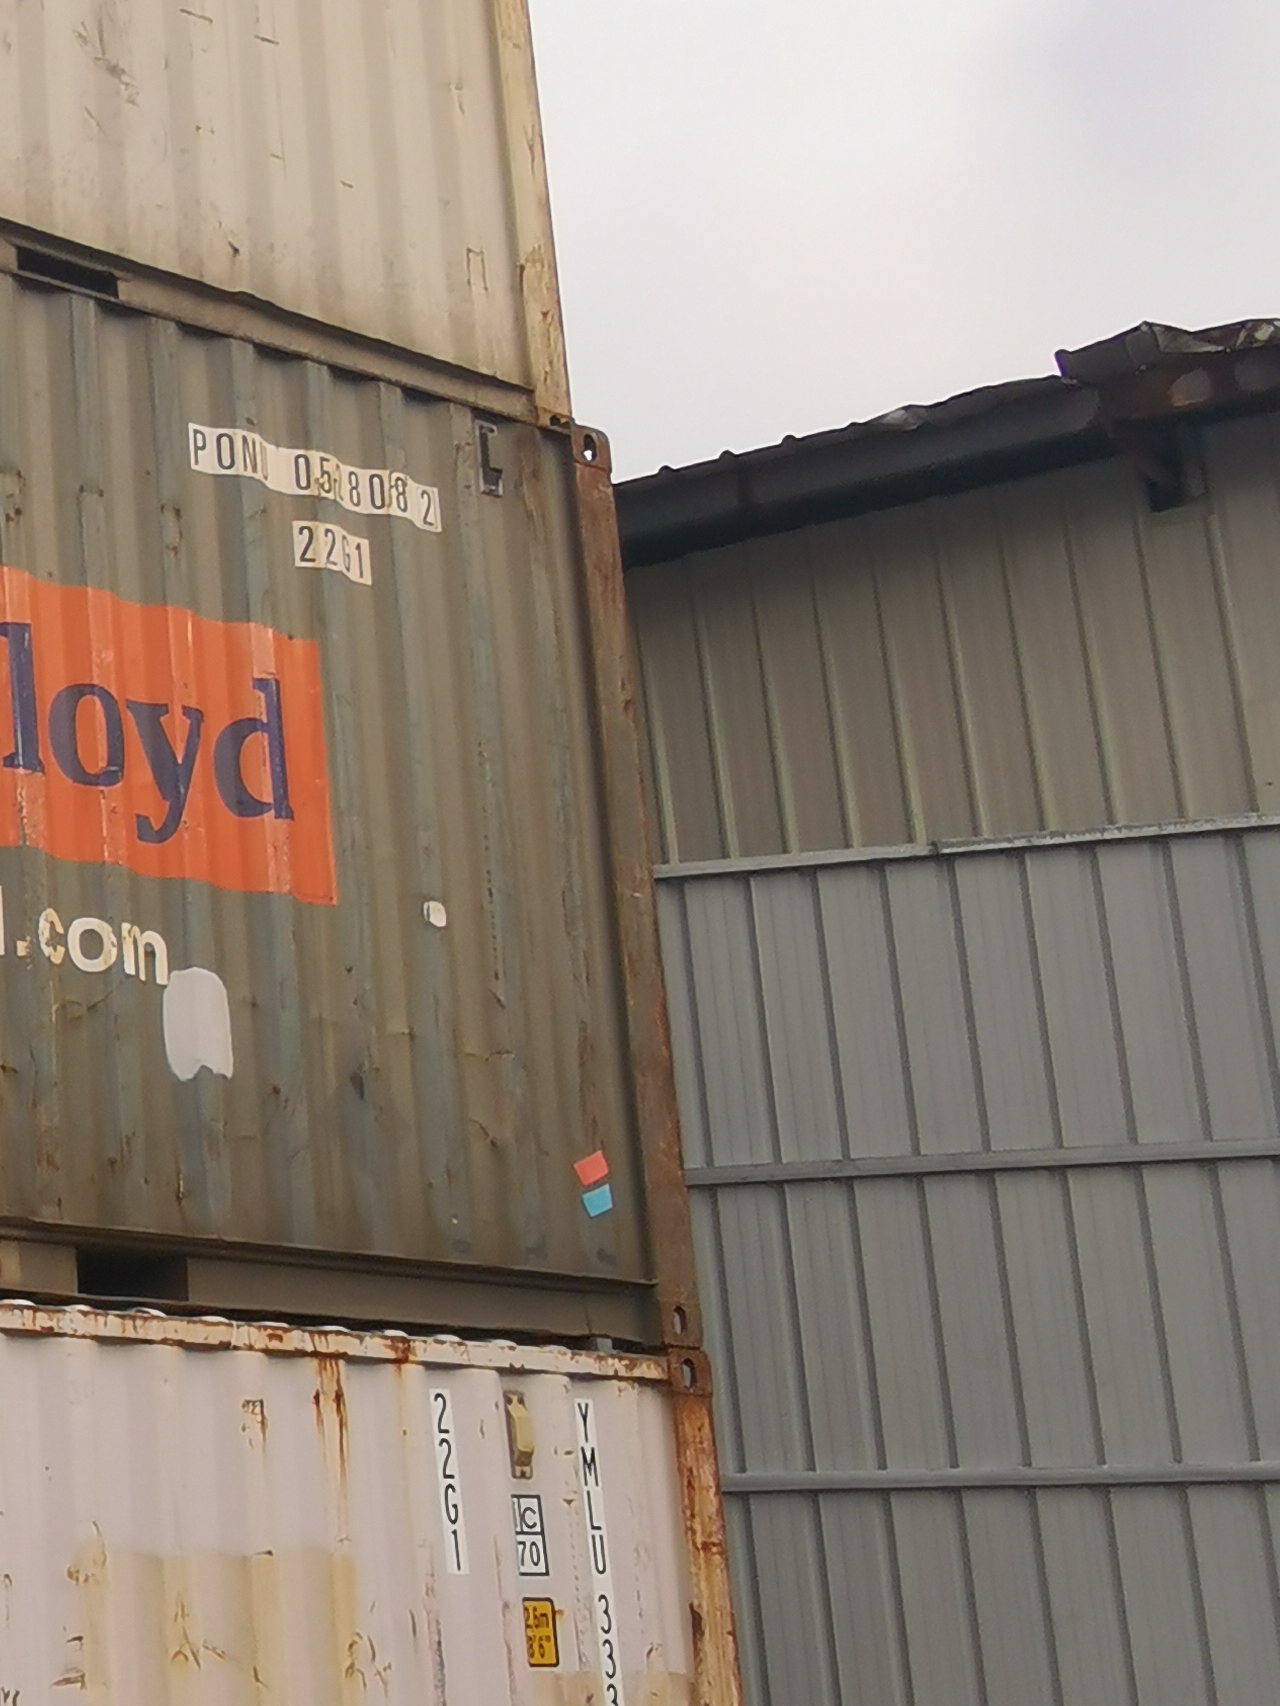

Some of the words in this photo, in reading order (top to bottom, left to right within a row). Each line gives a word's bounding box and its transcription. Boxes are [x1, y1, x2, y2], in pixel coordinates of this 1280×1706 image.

[297, 525, 365, 579] 22G1
[576, 1401, 607, 1575] YMLU
[517, 1540, 541, 1568] 70
